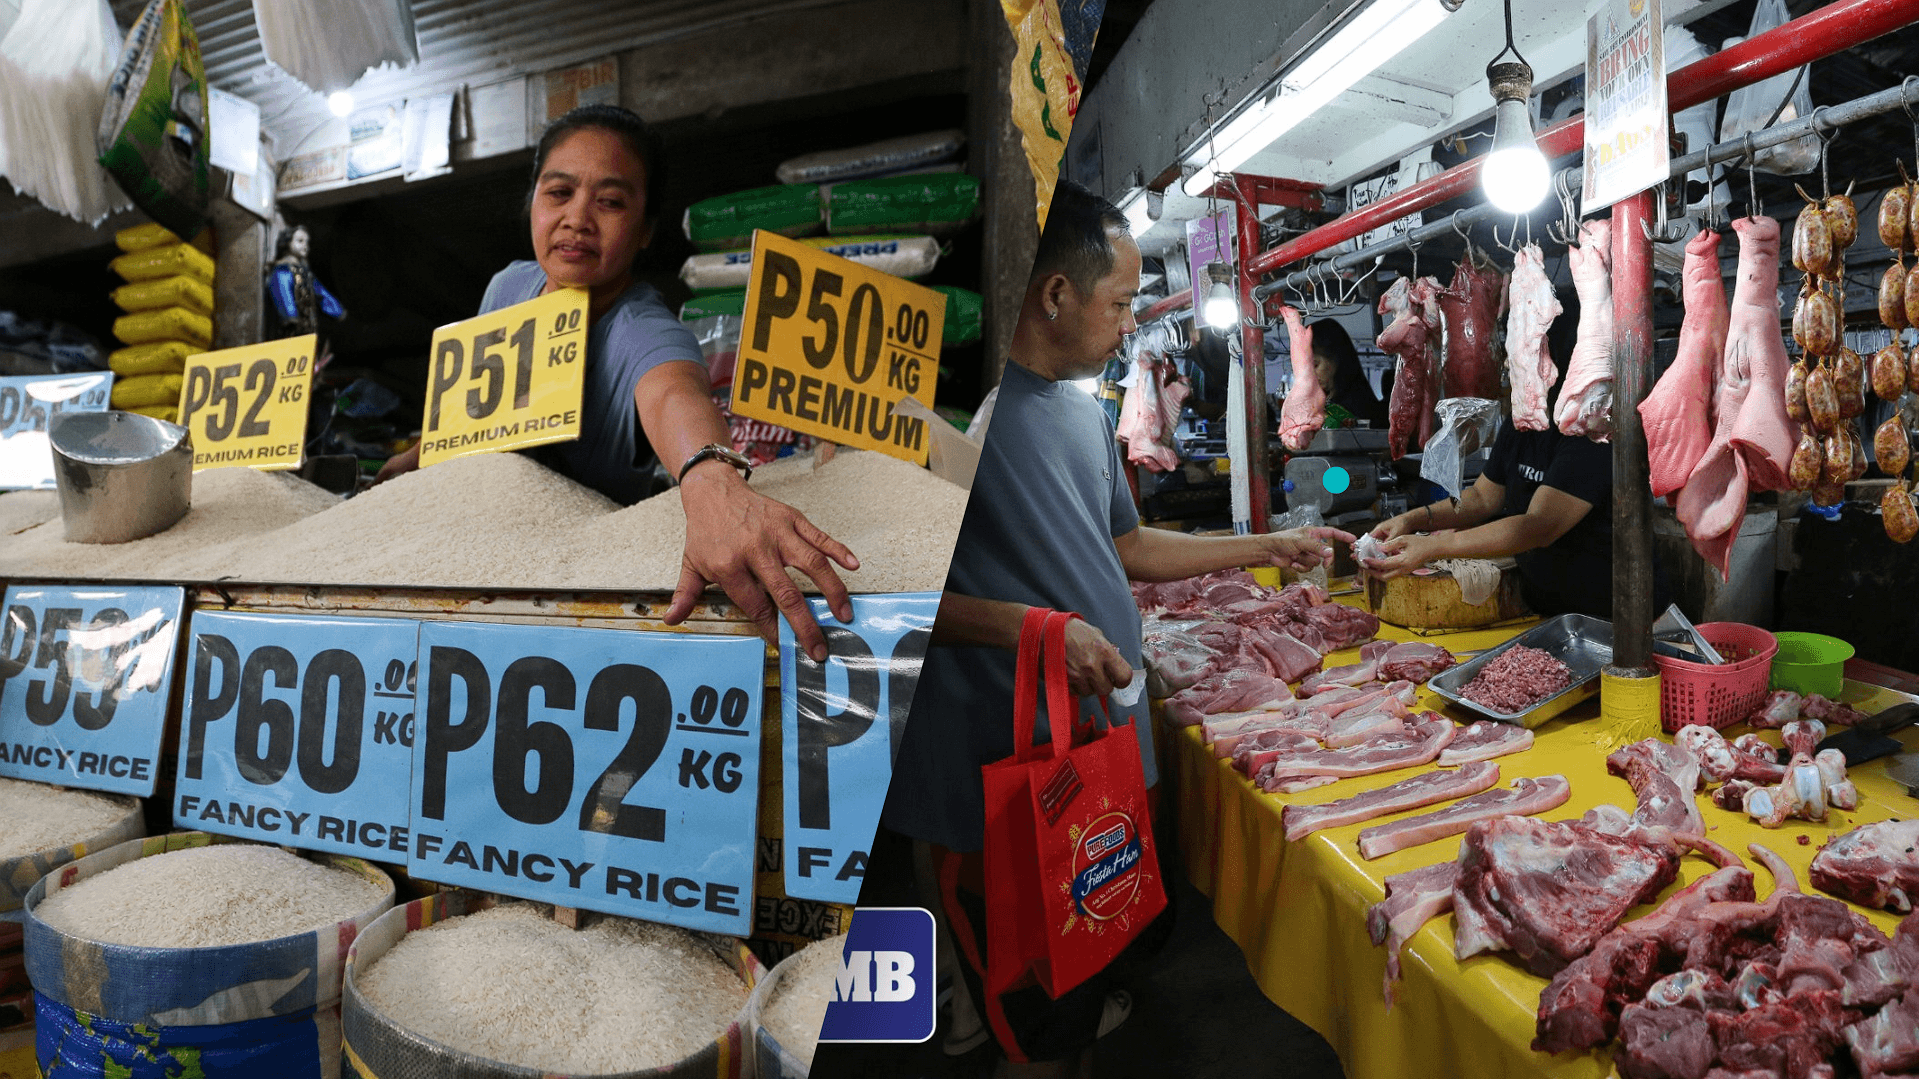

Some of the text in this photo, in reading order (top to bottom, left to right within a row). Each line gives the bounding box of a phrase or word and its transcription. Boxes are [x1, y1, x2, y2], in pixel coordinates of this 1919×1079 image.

[1600, 22, 1650, 89] BRING
[1600, 52, 1650, 104] YOUR OWN
[752, 248, 929, 384] P50 .00
[428, 308, 582, 433] P51 .00
[547, 342, 577, 368] KG
[887, 351, 921, 394] KG
[181, 355, 307, 442] P52 .00
[278, 384, 303, 404] KG
[740, 358, 924, 451] PREMIUM
[256, 443, 299, 459] RICE
[422, 410, 577, 454] PREMIUM RICE
[185, 634, 366, 794] P60
[78, 751, 151, 781] RICE
[421, 645, 750, 843] P62 .00
[677, 747, 743, 793] KG
[180, 795, 409, 853] FANCY RICE
[1087, 828, 1125, 856] PUREFOODS
[415, 833, 741, 917] FANCY RICE
[1081, 863, 1114, 896] Fiesta
[1112, 845, 1139, 874] Ham
